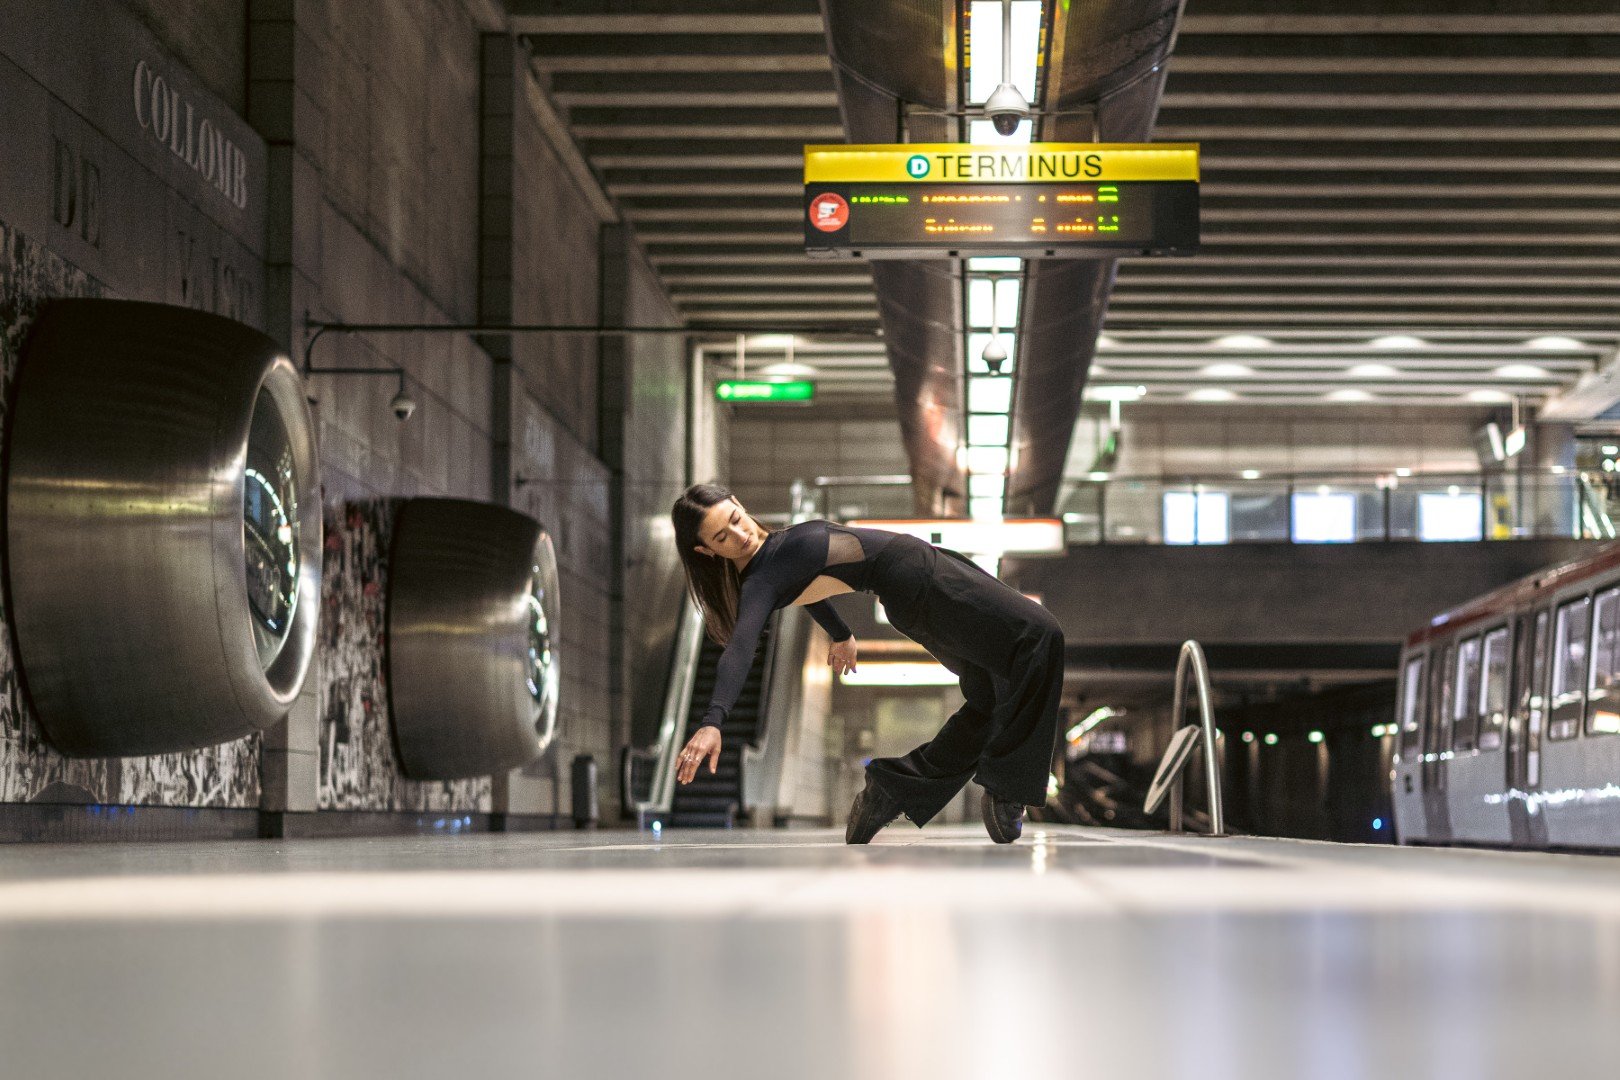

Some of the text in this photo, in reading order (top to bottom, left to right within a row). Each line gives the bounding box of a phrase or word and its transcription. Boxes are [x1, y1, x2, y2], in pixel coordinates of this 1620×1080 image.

[133, 60, 248, 210] COLLOMB
[909, 155, 1102, 178] D TERMINUS
